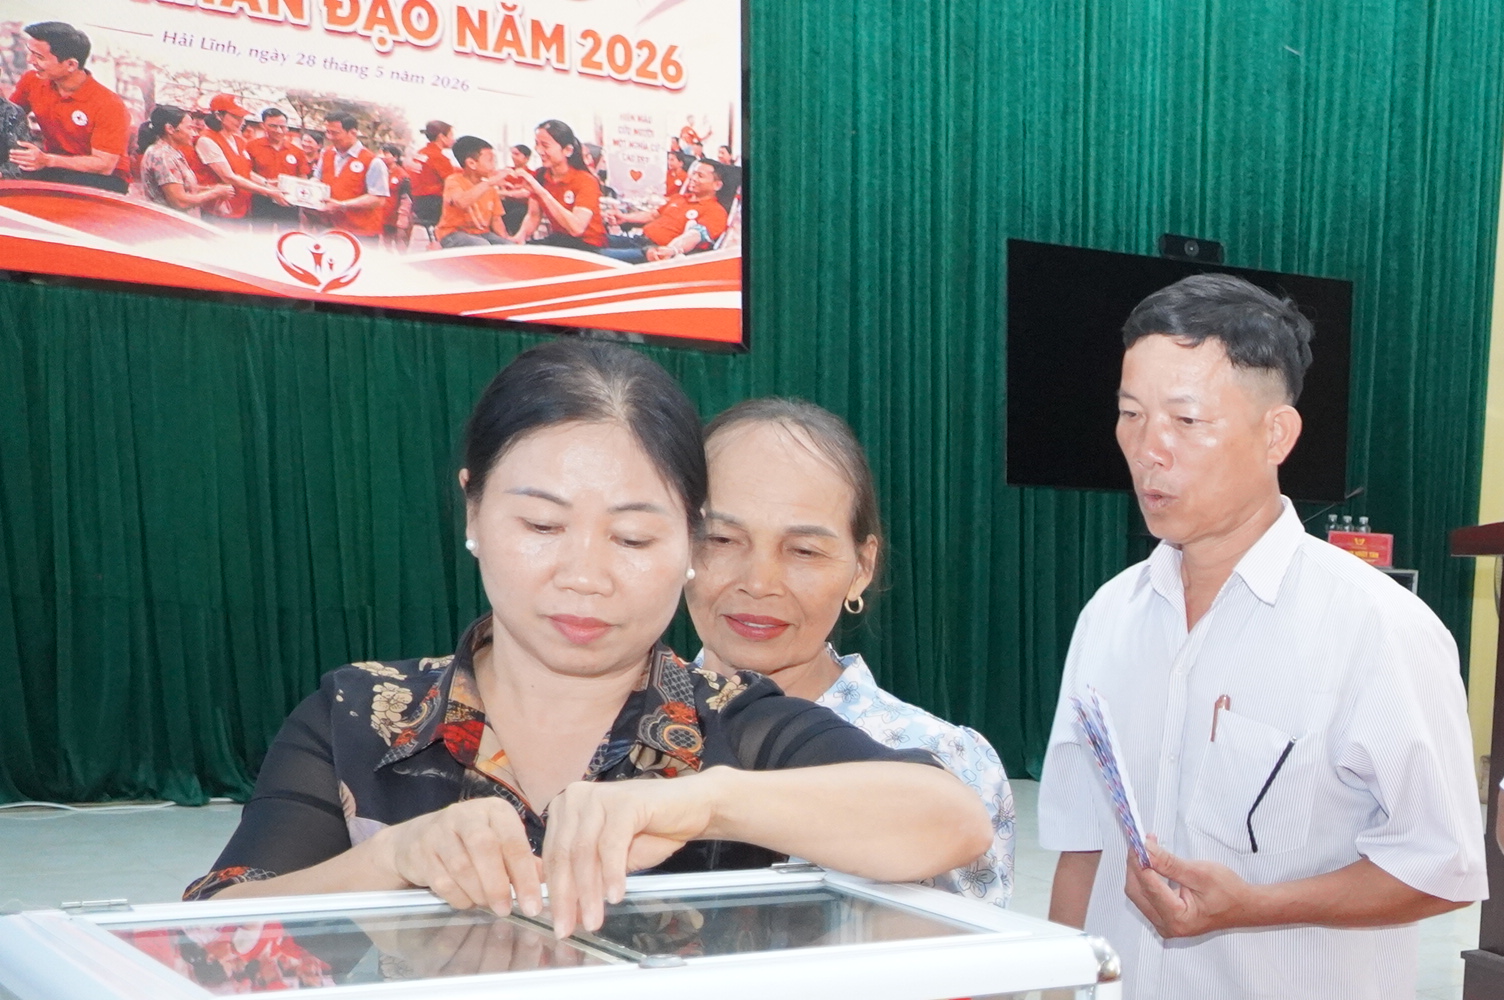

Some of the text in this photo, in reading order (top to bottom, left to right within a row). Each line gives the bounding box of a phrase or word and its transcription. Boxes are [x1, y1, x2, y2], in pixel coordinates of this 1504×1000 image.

[162, 31, 194, 47] Hải
[249, 47, 289, 66] ngày
[295, 53, 316, 67] 28
[323, 57, 369, 79] tháng
[375, 65, 384, 78] 5
[431, 74, 470, 92] 2026
[324, 0, 440, 48] ĐẠO
[456, 2, 566, 66] NĂM
[579, 28, 684, 84] 2026
